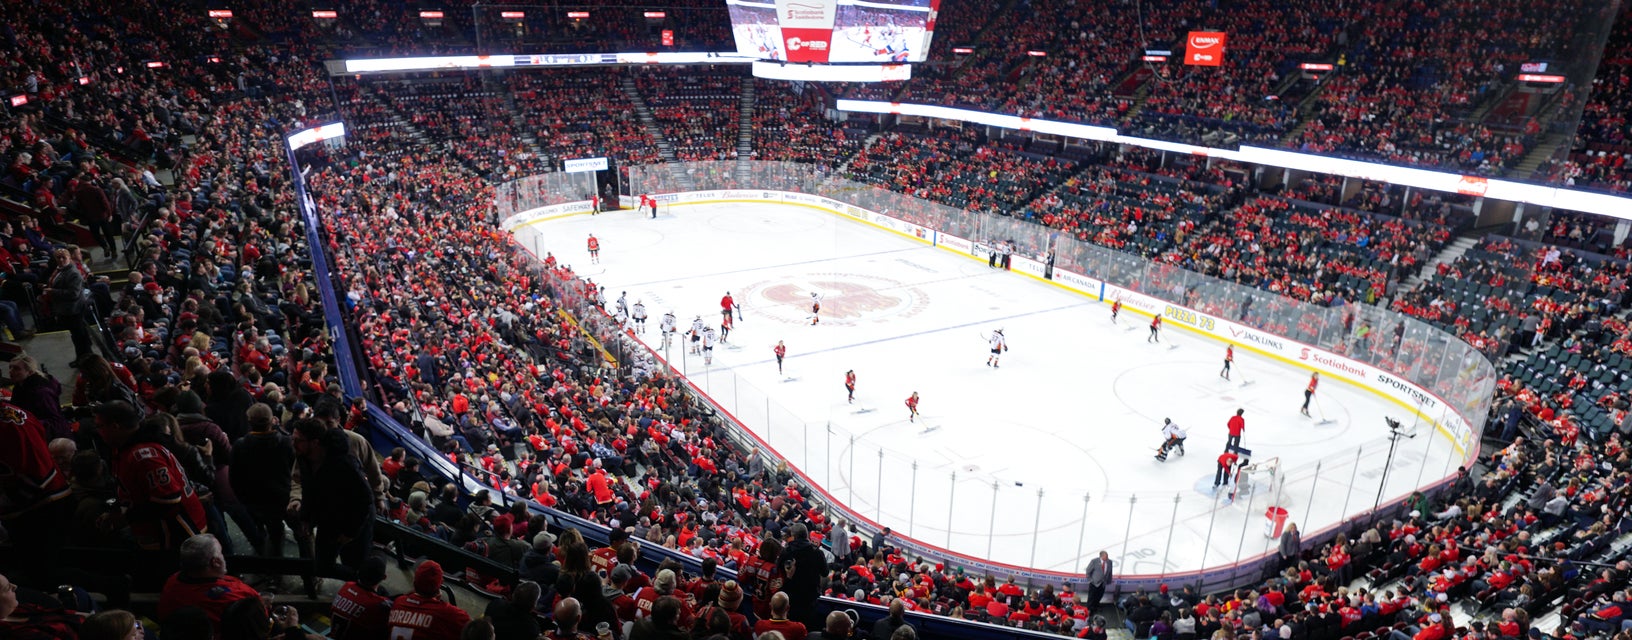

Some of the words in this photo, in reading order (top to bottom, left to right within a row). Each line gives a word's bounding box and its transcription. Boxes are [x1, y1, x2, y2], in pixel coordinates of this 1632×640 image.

[1072, 277, 1096, 290] CANADA
[1109, 288, 1155, 310] Budweiser
[1165, 305, 1198, 326] PIZZA
[1199, 317, 1216, 331] 73
[1312, 353, 1367, 379] Scotiabank
[1377, 374, 1437, 409] SPORTSNET
